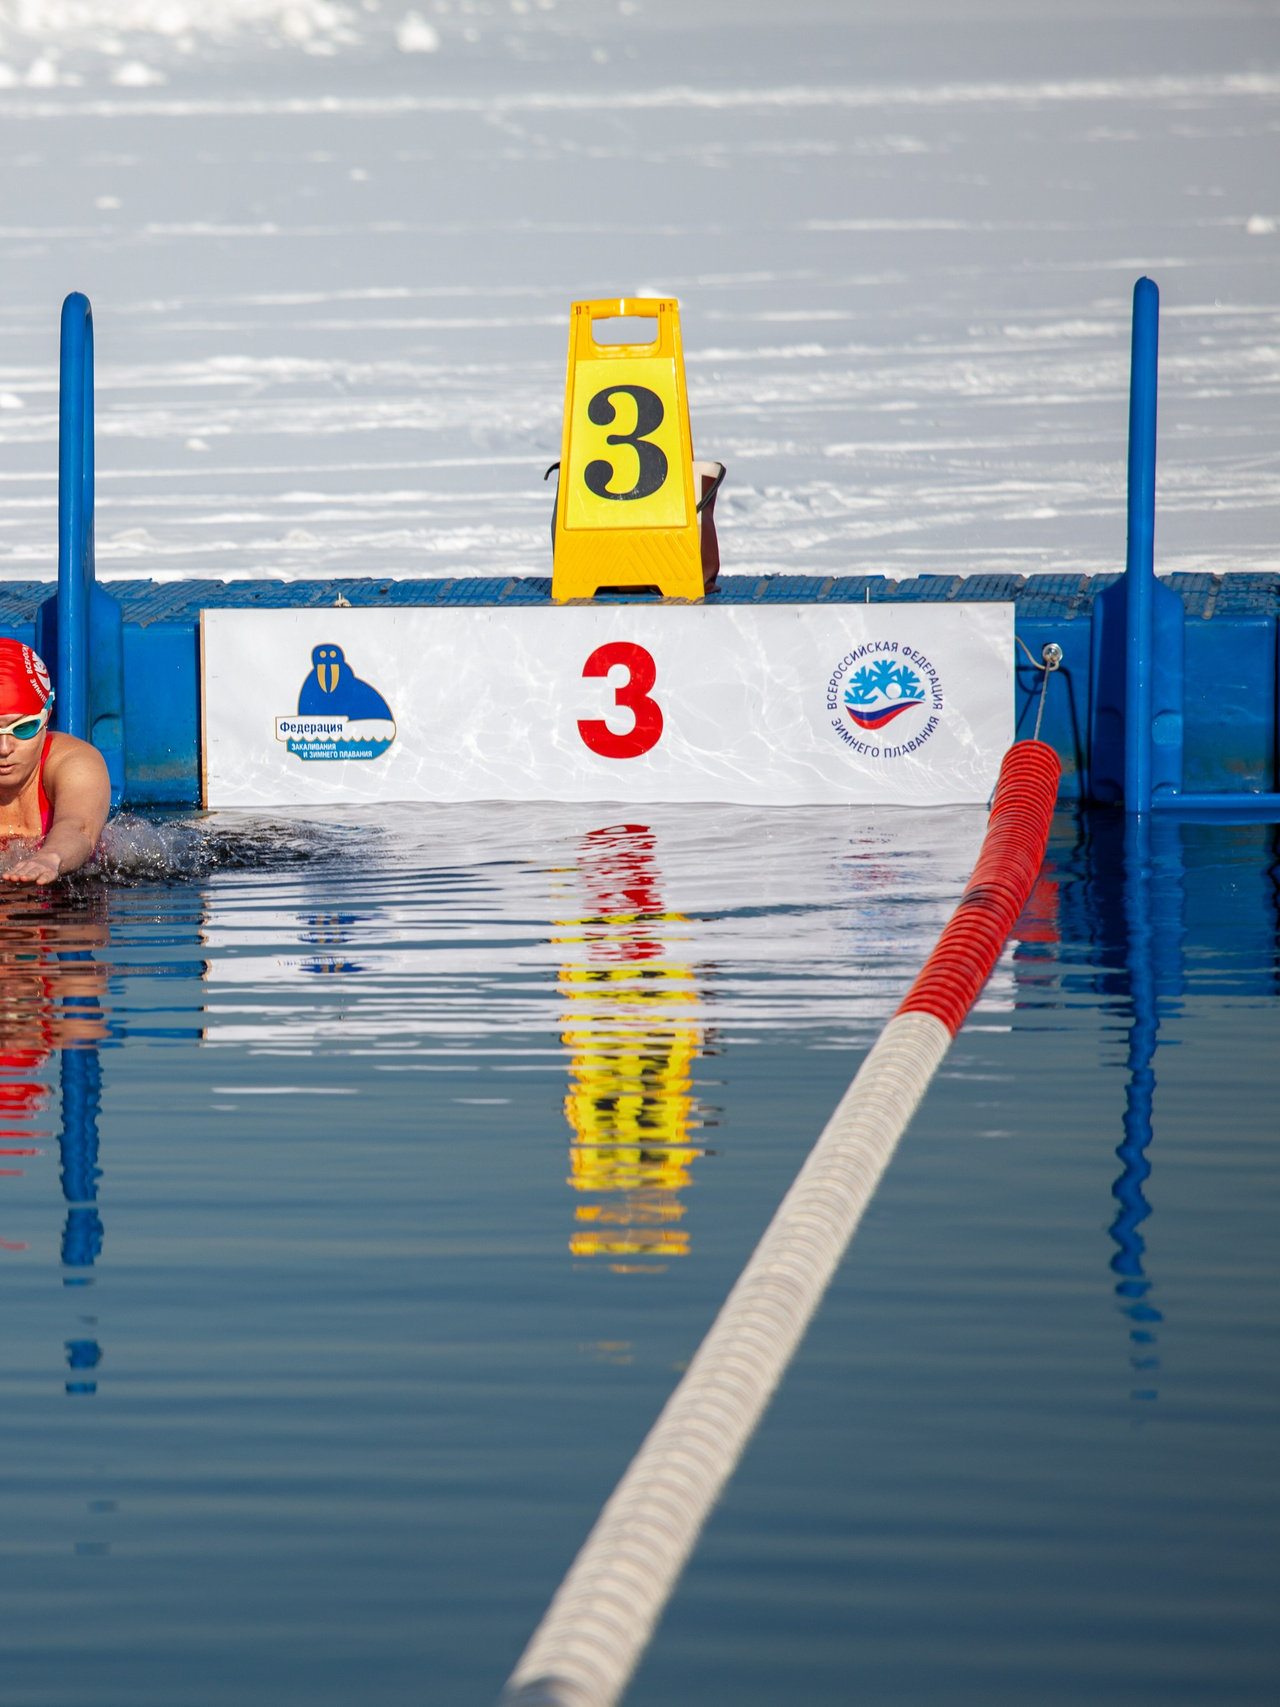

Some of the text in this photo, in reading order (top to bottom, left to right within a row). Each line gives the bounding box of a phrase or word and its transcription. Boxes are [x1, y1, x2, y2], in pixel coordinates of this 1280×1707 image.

[584, 385, 668, 501] 3
[577, 642, 663, 759] 3
[827, 641, 943, 710] ВСЕРОССИЙСКАЯ ФЕДЕРАЦИЯ
[280, 722, 343, 734] Федерация
[832, 716, 940, 758] ЗИМНЕГО ПЛАВАНИЯ
